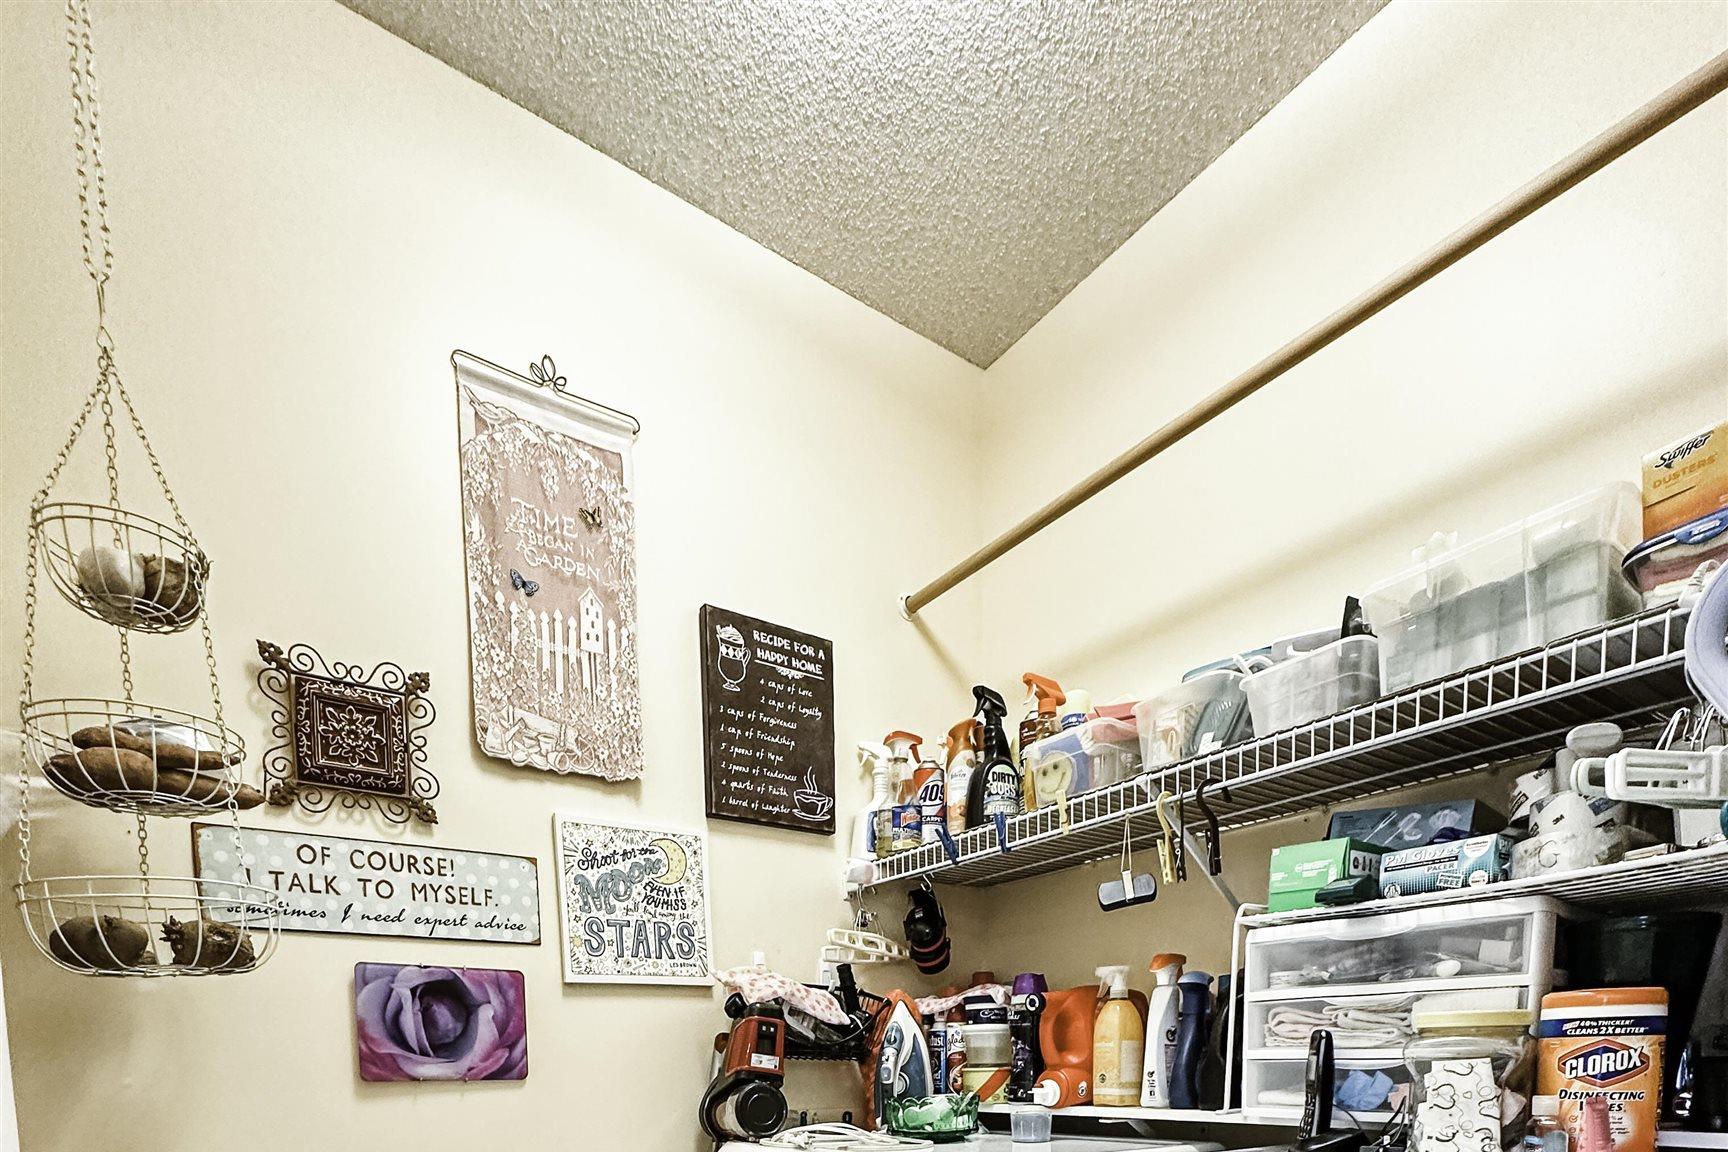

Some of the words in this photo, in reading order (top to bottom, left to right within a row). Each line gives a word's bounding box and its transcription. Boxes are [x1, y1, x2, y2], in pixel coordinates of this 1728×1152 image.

[1654, 434, 1712, 468] Swiffer
[1653, 455, 1715, 488] DUSTERS
[511, 497, 578, 538] TIME
[528, 530, 574, 553] BEGAN
[579, 545, 595, 559] IN
[524, 547, 600, 580] GARDEN
[753, 630, 790, 650] RECIPE
[794, 641, 815, 657] FOR
[818, 649, 825, 660] A
[757, 648, 788, 665] HAPPY
[792, 657, 822, 675] HOME
[788, 684, 795, 694] of
[788, 702, 795, 712] of
[748, 710, 756, 721] of
[759, 712, 797, 729] Forgiveness
[745, 728, 753, 739] of
[757, 730, 796, 751] Friendship
[730, 745, 753, 758] spoons
[756, 749, 764, 759] of
[767, 752, 784, 766] Hope
[728, 763, 749, 774] spoons
[752, 766, 760, 776] of
[763, 768, 797, 781] Tenderness
[992, 771, 1017, 784] DIRTY
[757, 783, 765, 794] of
[768, 785, 788, 797] Faith
[990, 781, 1016, 798] JOBS
[751, 800, 758, 810] of
[297, 844, 331, 866] OF
[349, 849, 455, 877] COURSE!
[578, 847, 619, 870] Shoot
[620, 848, 637, 861] for
[1384, 852, 1408, 867] PM
[1411, 846, 1461, 860] Gloves
[1426, 863, 1455, 872] PACER
[268, 870, 341, 896] TALK
[358, 878, 394, 900] TO
[410, 882, 500, 907] MYSELF.
[643, 881, 671, 898] EVEN
[674, 886, 685, 898] IF
[1439, 878, 1460, 887] FREE
[641, 892, 660, 908] YOU
[661, 899, 687, 911] MISS
[361, 906, 407, 923] need
[414, 914, 468, 936] expert
[474, 913, 527, 932] advice
[584, 917, 695, 960] STARS
[1567, 1027, 1599, 1035] CLEANS
[1580, 1019, 1598, 1027] 40%
[1564, 1046, 1643, 1079] CLOROX
